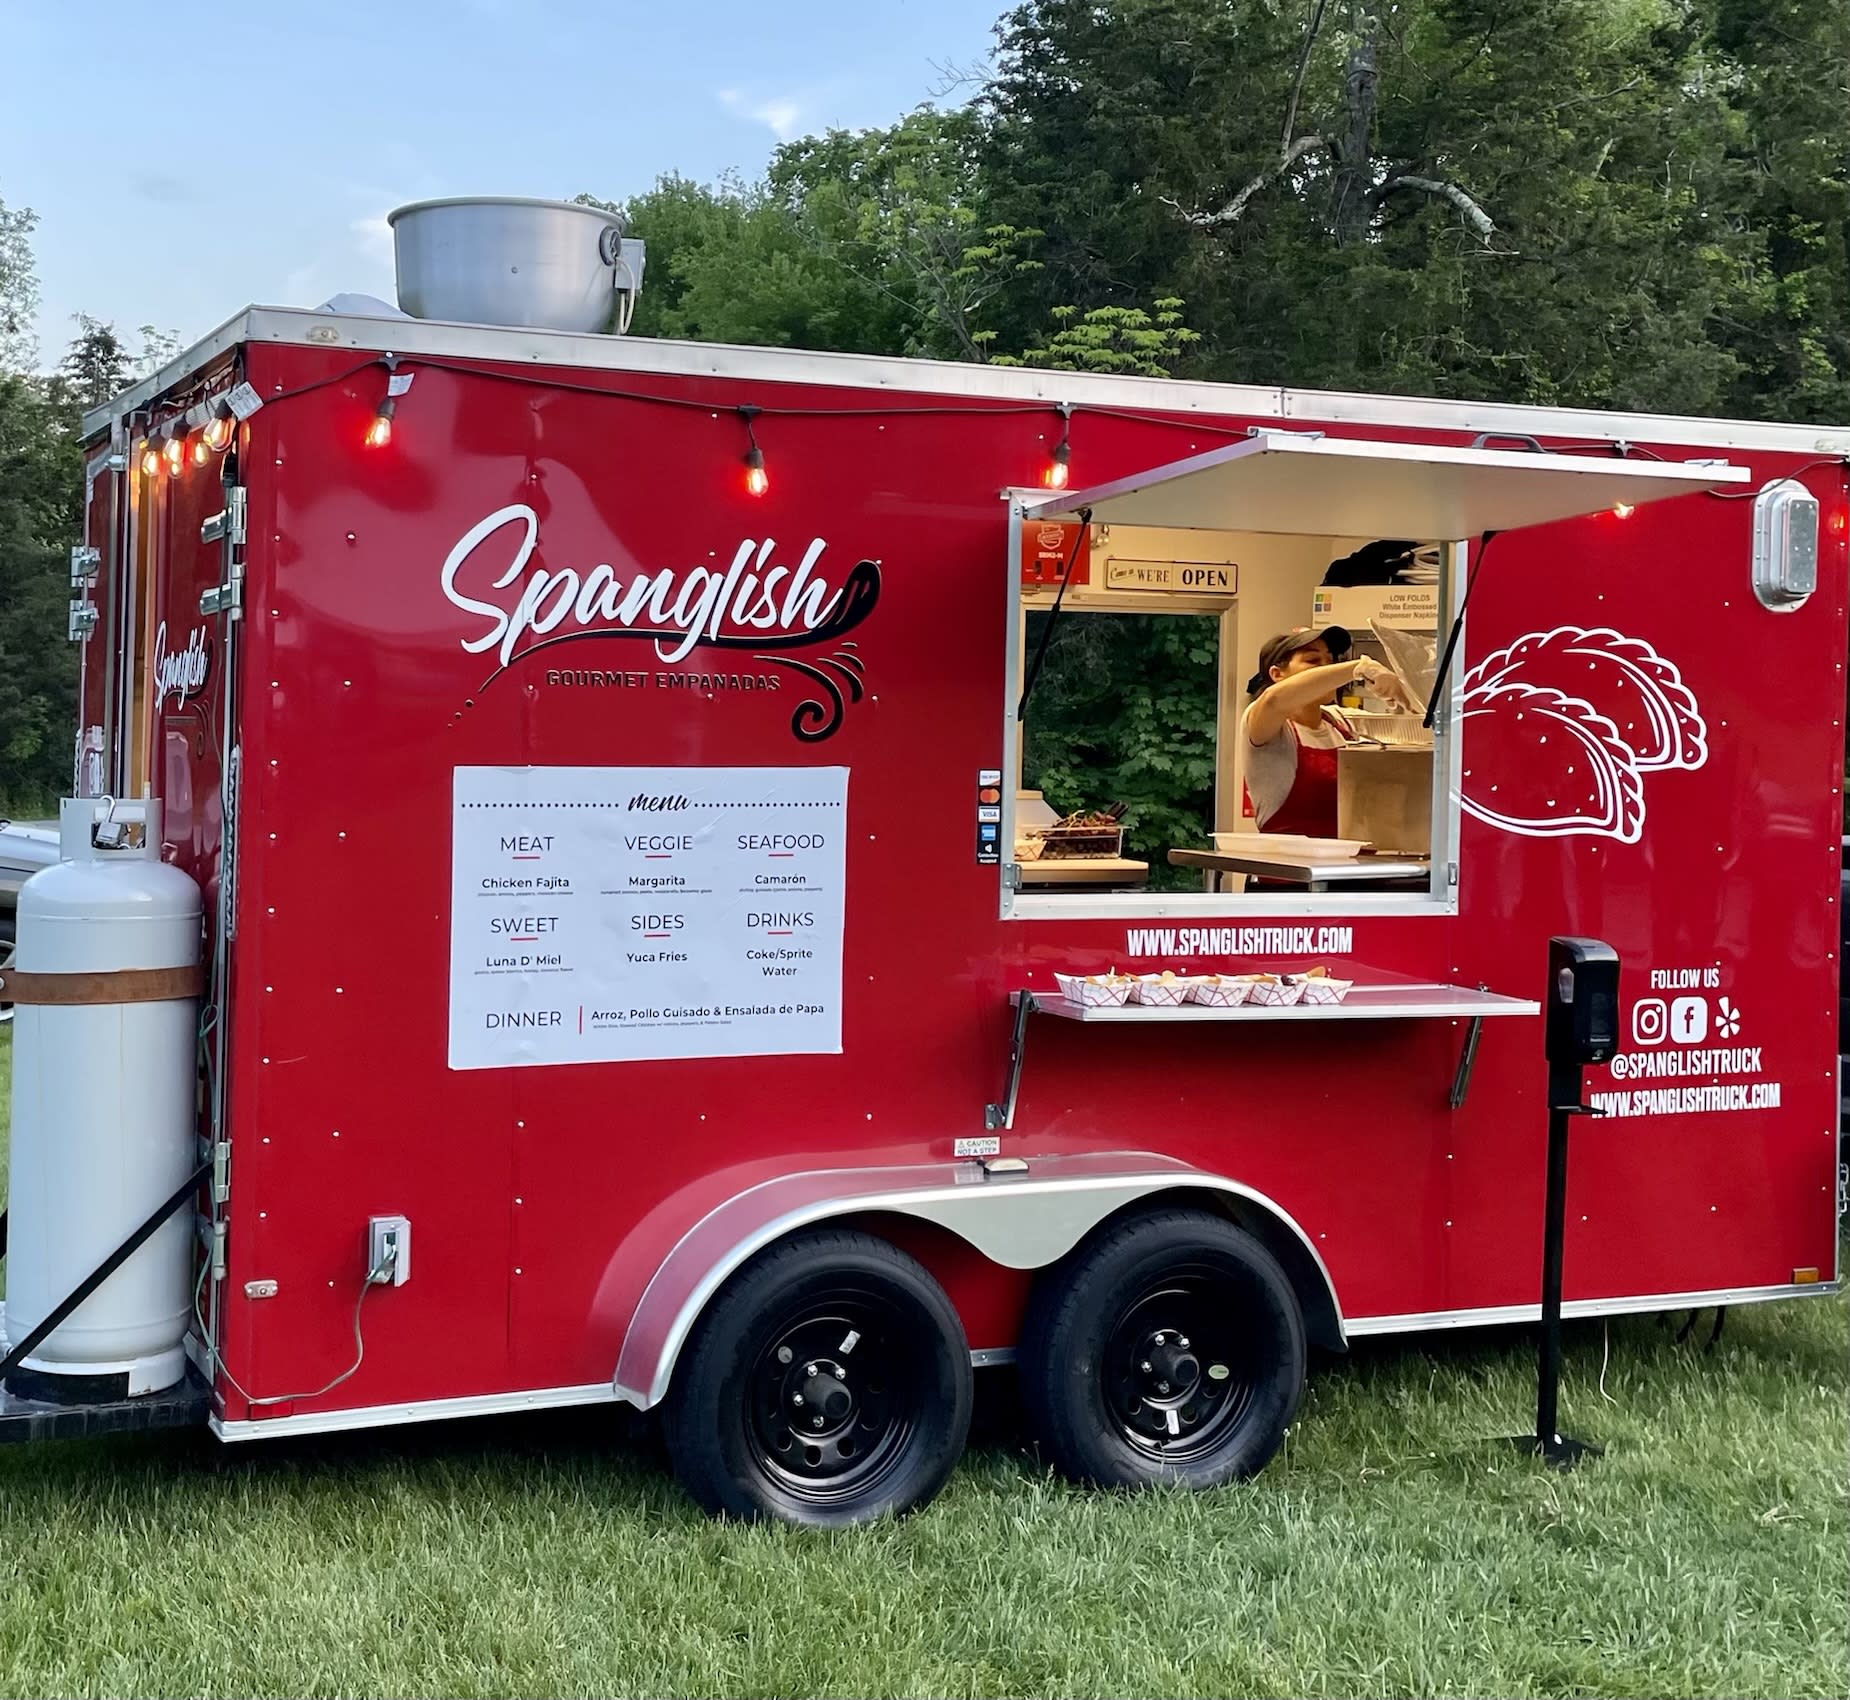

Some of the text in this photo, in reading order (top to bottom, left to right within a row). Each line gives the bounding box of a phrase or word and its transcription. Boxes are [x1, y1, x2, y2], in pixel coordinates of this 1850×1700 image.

[1137, 568, 1170, 583] WE'RE
[1182, 568, 1228, 586] OPEN
[440, 503, 843, 668] Spanglish
[1389, 594, 1430, 602] LOW FOLDS
[153, 619, 208, 715] Spanglish
[546, 668, 781, 691] GOURMET EMPANADAS
[627, 792, 693, 813] menu
[499, 836, 555, 852] MEAT
[624, 835, 694, 851] VEGGIE
[737, 834, 825, 850] SEAFOOD
[481, 876, 570, 890] Chicken Fajita
[628, 875, 686, 888] Margarita
[755, 873, 806, 885] Camarón
[490, 917, 559, 933] SWEET
[630, 915, 685, 930] SIDES
[746, 912, 815, 928] DRINKS
[1127, 927, 1354, 957] WWW.SPANGLISHTRUCK.COM
[486, 954, 562, 967] Luna D' Miel
[626, 951, 688, 963] Yuca Fries
[746, 947, 813, 962] Coke/Sprite
[762, 965, 797, 976] Water
[1651, 968, 1720, 990] FOLLOW US
[486, 1011, 562, 1029] DINNER
[591, 1003, 825, 1022] Arroz, Pollo Guisado & Ensalada de Papa
[1610, 1047, 1763, 1080] @SPANGLISHTRUCK
[1590, 1082, 1781, 1119] WWW.SPANGLISHTRUCK.COM
